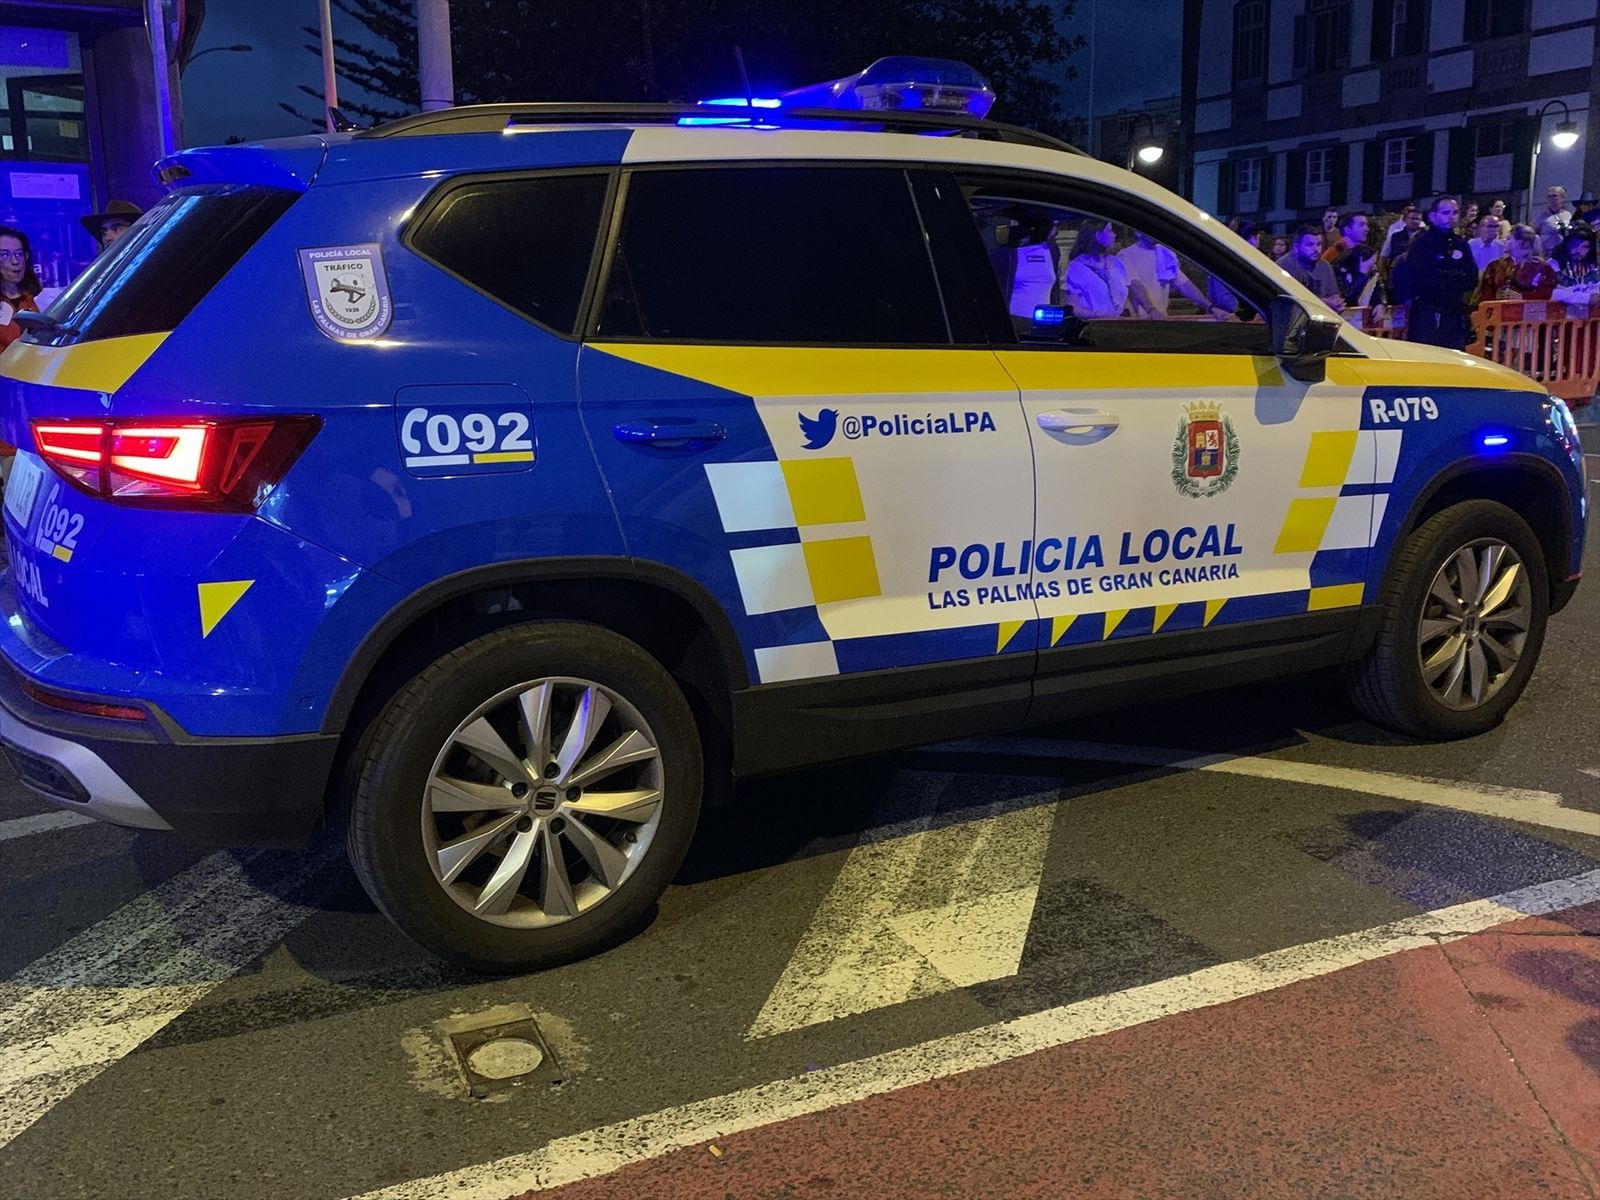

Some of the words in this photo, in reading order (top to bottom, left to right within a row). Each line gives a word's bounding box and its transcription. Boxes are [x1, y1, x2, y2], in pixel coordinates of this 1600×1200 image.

[309, 249, 343, 259] POLICÍA
[344, 248, 372, 257] LOCAL
[312, 299, 322, 314] LAS
[318, 315, 345, 337] PALMAS
[359, 325, 379, 338] GRAN
[378, 295, 389, 327] CANARIA
[842, 411, 997, 440] @PolicíaLPA
[1369, 396, 1439, 424] R-079
[928, 534, 1105, 583] POLICIA
[1118, 523, 1243, 566] LOCAL
[928, 588, 970, 610] LAS
[977, 579, 1061, 605] PALMAS
[1067, 576, 1092, 595] DE
[1099, 568, 1153, 593] GRAN
[1159, 562, 1239, 586] CANARIA
